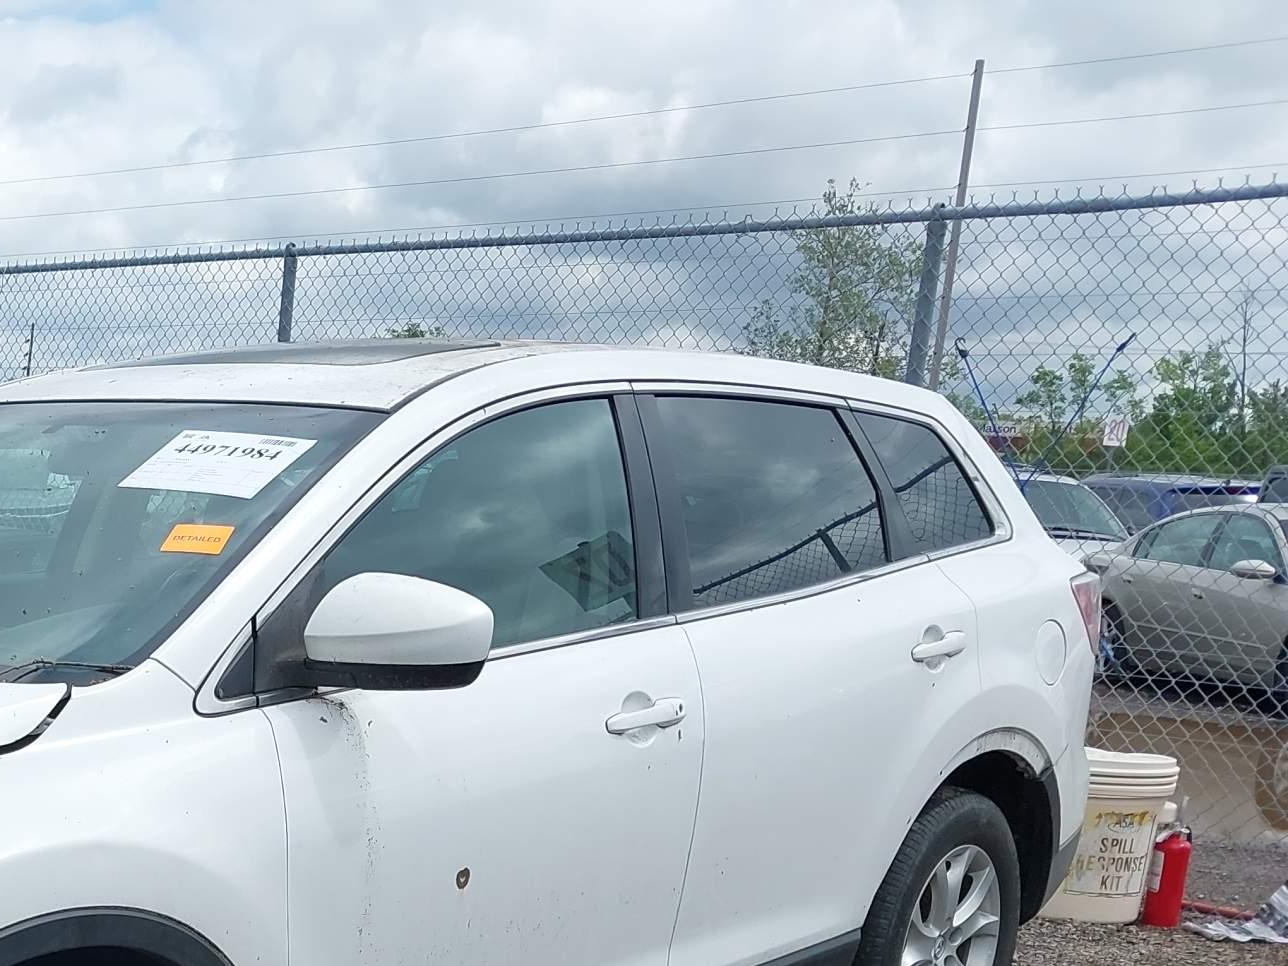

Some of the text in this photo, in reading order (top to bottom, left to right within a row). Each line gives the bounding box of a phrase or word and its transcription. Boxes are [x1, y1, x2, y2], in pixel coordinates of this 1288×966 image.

[174, 443, 283, 461] 44971984
[172, 535, 222, 543] DETAILED
[1100, 838, 1134, 854] SPILL
[1099, 874, 1124, 891] KIT
